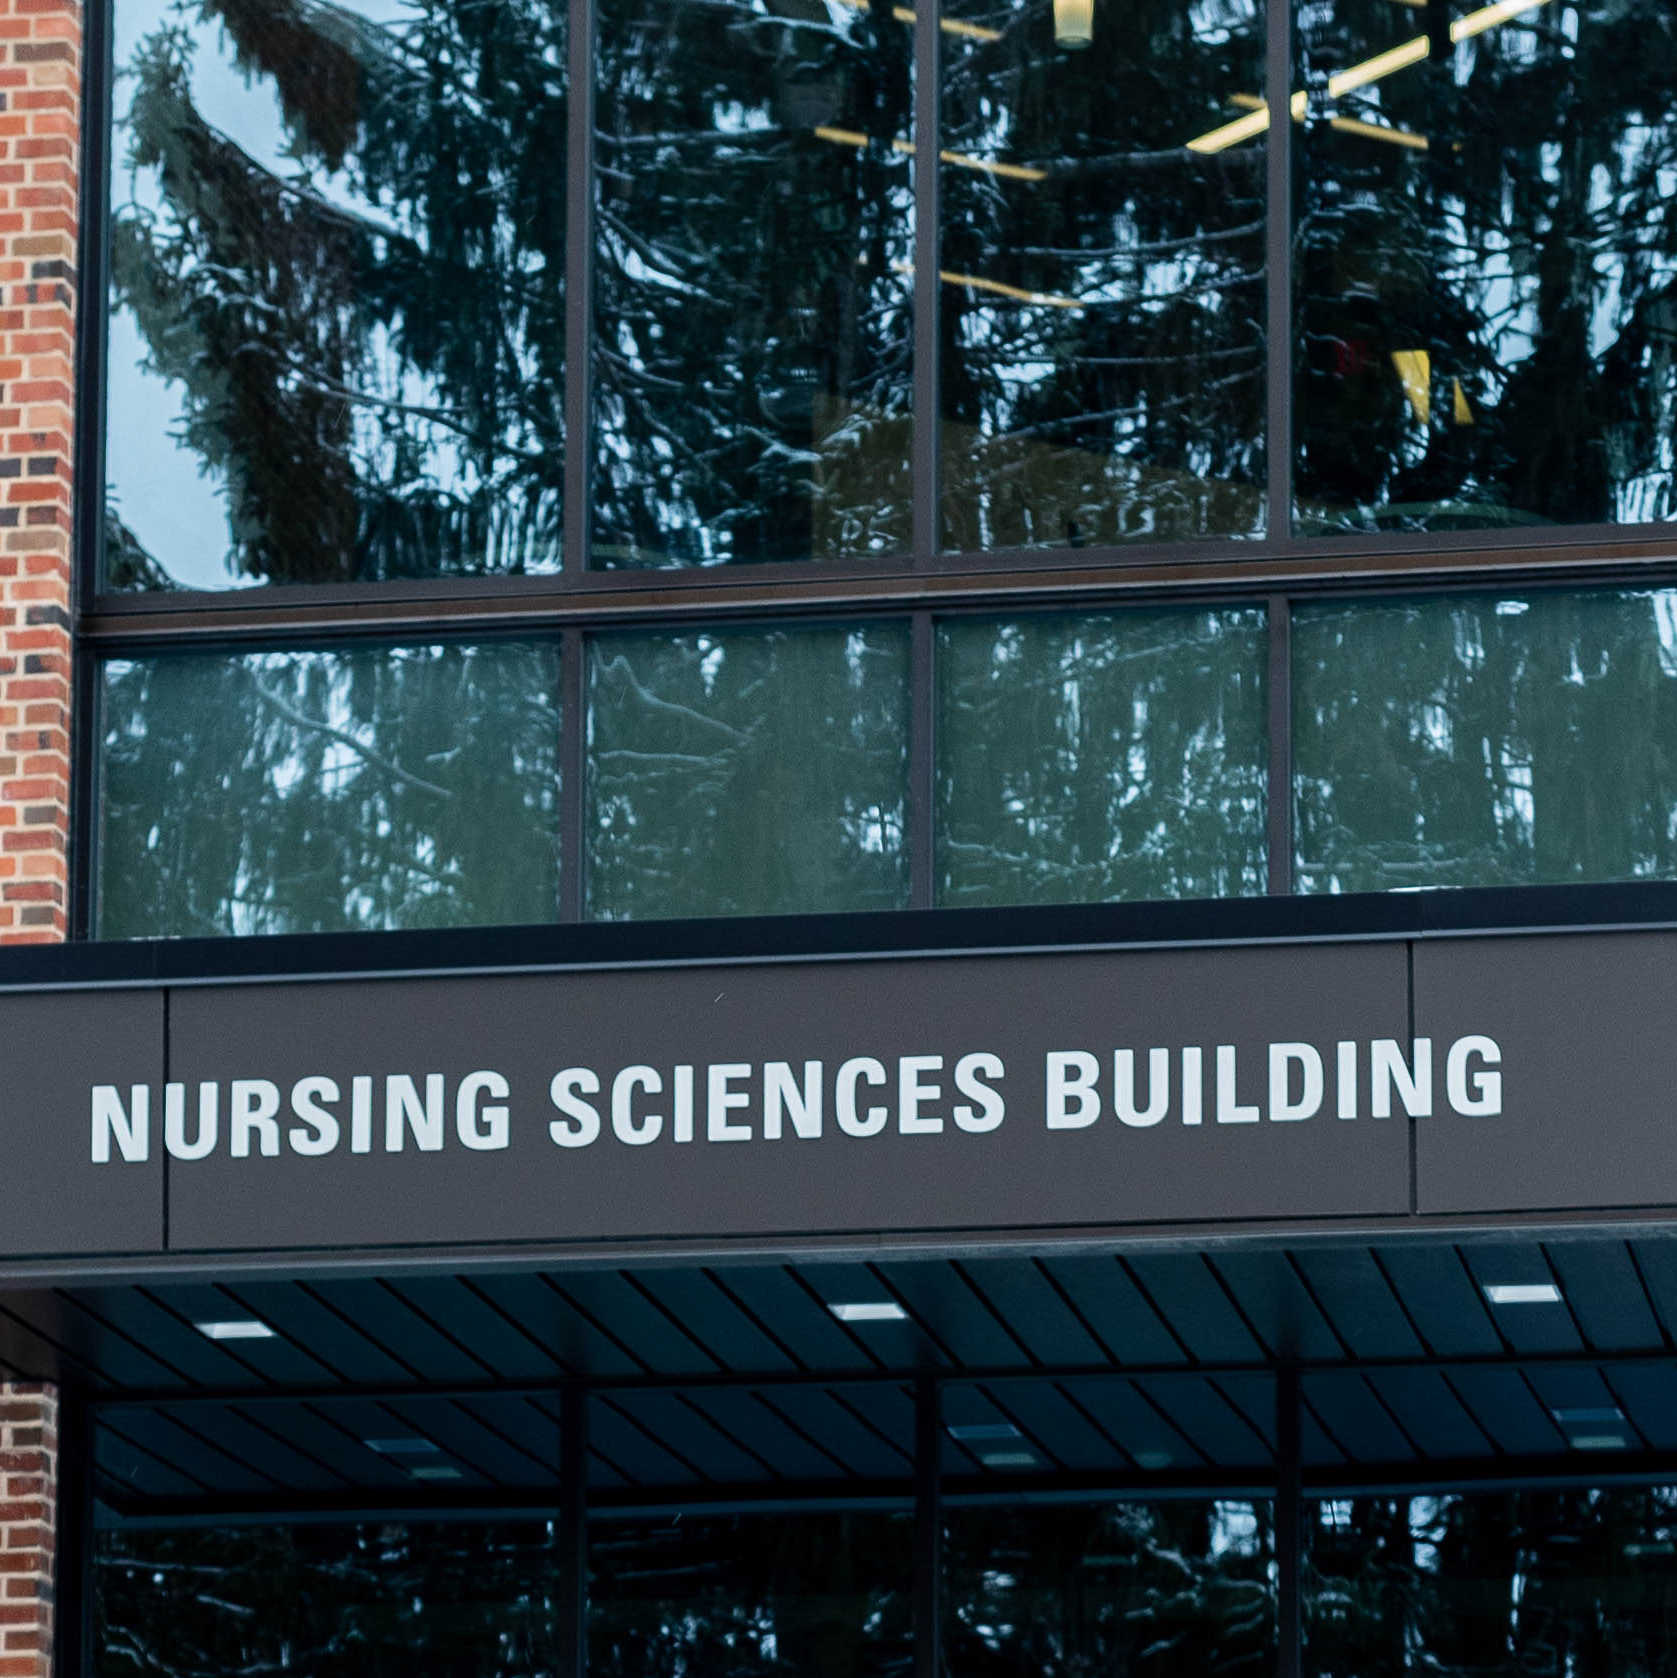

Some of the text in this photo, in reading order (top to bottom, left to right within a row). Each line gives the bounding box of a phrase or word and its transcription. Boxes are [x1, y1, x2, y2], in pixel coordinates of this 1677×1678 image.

[90, 1034, 1503, 1163] NURSING SCIENCES BUILDING
